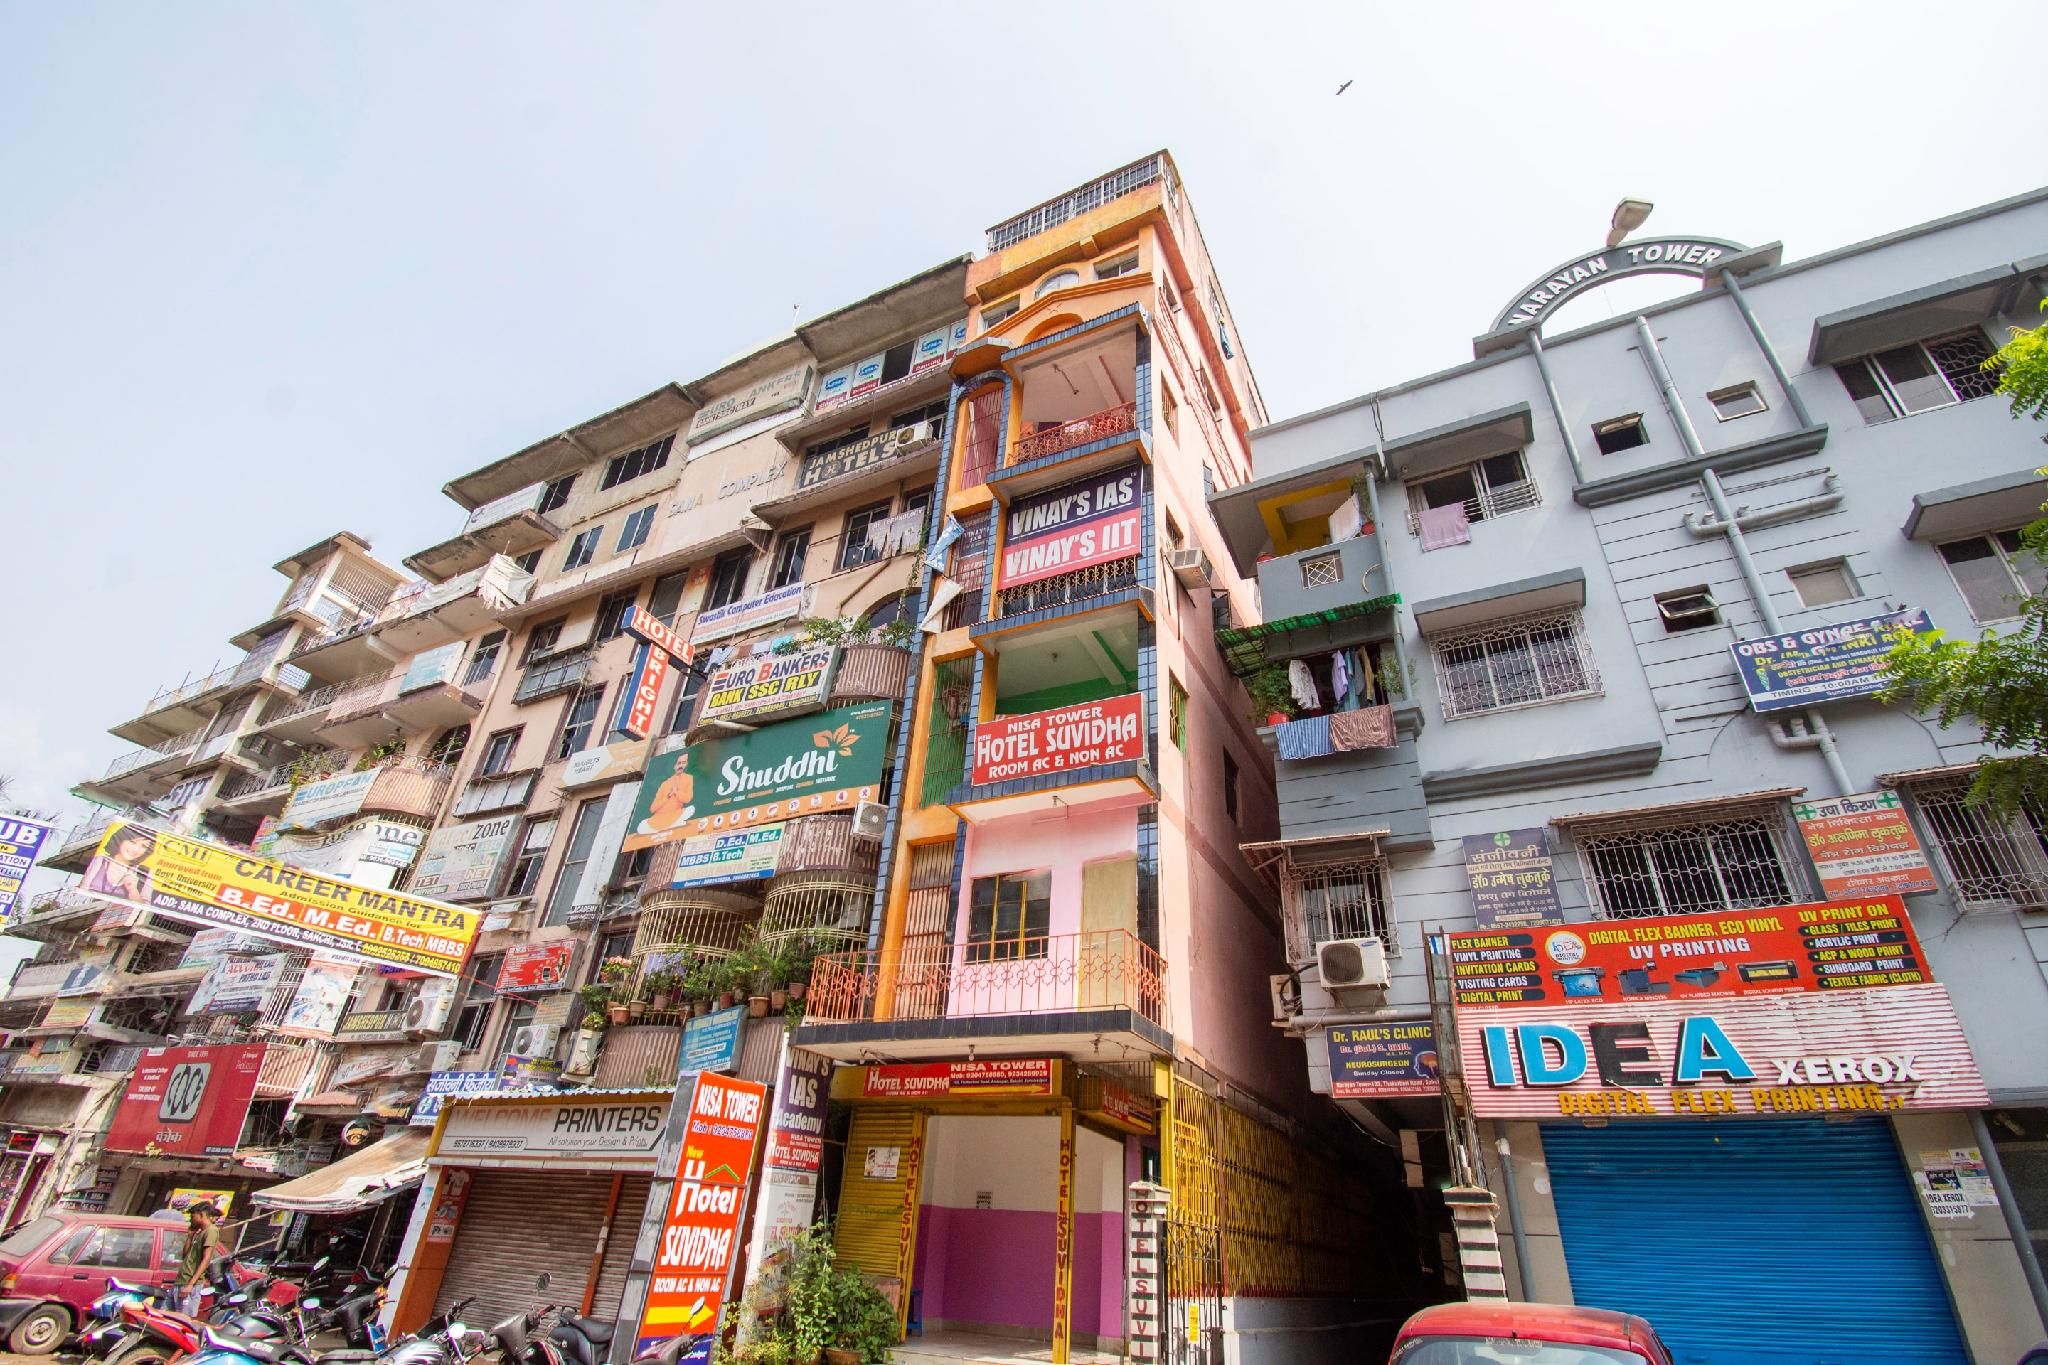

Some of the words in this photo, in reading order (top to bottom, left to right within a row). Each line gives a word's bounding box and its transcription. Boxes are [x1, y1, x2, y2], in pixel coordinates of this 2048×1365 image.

[1508, 257, 1608, 326] NARAYAN
[1628, 245, 1722, 264] TOWER
[809, 430, 897, 469] JAMSHEDPUR
[719, 461, 788, 499] COMPLEX
[1013, 490, 1091, 536] VINAY'S
[1095, 477, 1133, 511] IAS
[1005, 529, 1095, 578] VINAY'S
[1101, 517, 1137, 551] IIT
[636, 607, 692, 665] HOTEL
[1739, 640, 1778, 657] OBS
[1781, 637, 1797, 649] &
[712, 668, 756, 692] EURO
[757, 651, 829, 682] BANKERS
[633, 644, 669, 729] BRIGHT
[748, 680, 780, 700] SSC
[783, 671, 819, 692] RLY
[1770, 686, 1811, 698] TIMING
[1008, 718, 1041, 734] NISA
[1046, 706, 1102, 725] TOWER
[977, 730, 1039, 768] HOTEL
[1046, 712, 1137, 753] SUVIDHA
[989, 761, 1028, 779] ROOM
[1032, 756, 1050, 771] AC
[1054, 754, 1064, 767] &
[1069, 748, 1100, 764] NON
[1105, 743, 1124, 760] AC
[718, 751, 840, 796] Shuddhi
[1840, 799, 1878, 815] किरण
[716, 835, 746, 849] D.Ed.
[748, 830, 780, 845] M.Ed.
[680, 853, 710, 867] MBBS
[712, 849, 743, 862] B.Tech
[234, 858, 350, 902] CAREER
[357, 890, 466, 931] MANTRA
[178, 899, 205, 915] SANA
[221, 886, 296, 919] B.Ed.
[304, 907, 378, 939] M.Ed.
[279, 890, 345, 911] Admission
[347, 905, 403, 926] Guidance
[1799, 909, 1816, 923] UV
[1819, 905, 1862, 921] PRINT
[1868, 903, 1889, 917] ON
[382, 925, 424, 949] B.Tech
[1589, 929, 1631, 945] DIGITAL
[1633, 927, 1662, 942] FLEX
[1663, 922, 1718, 940] BANNER,
[1719, 920, 1746, 934] ECO
[1746, 916, 1784, 933] VINYL
[1808, 923, 1839, 935] GLASS
[1845, 921, 1868, 932] TILES
[1869, 918, 1898, 930] PRINT
[426, 934, 466, 957] MBBS
[1451, 938, 1473, 950] FLEX
[1474, 936, 1509, 947] BANNER
[1629, 945, 1655, 960] UV
[1660, 937, 1751, 959] PRINTING
[1814, 936, 1852, 948] ACRYLIC
[1853, 933, 1880, 945] PRINT
[1819, 949, 1838, 961] ACP
[1839, 948, 1847, 959] &
[1848, 946, 1876, 959] WOOD
[1877, 944, 1905, 956] PRINT
[1453, 951, 1479, 963] VINYL
[1480, 948, 1521, 961] PRINTING
[1823, 961, 1872, 974] SUNBOARD
[1877, 958, 1904, 970] PRINT
[1456, 964, 1504, 976] INVITATION
[1505, 961, 1536, 973] CARDS
[1826, 976, 1858, 988] TEXTILE
[1859, 973, 1888, 985] FABRIC
[1889, 971, 1922, 984] (CLOTH)
[1458, 978, 1496, 989] VISITING
[1497, 975, 1528, 987] CARDS
[1461, 992, 1495, 1003] DIGITAL
[1496, 989, 1523, 1001] PRINT
[1333, 1031, 1349, 1042] Dr.
[1352, 1029, 1391, 1041] RAUL'S
[1393, 1027, 1432, 1039] CLINIC
[1479, 1015, 1758, 1089] IDEA
[951, 1063, 987, 1072] NISA
[991, 1060, 1047, 1070] TOWER
[1345, 1060, 1410, 1069] NEUROSURGEON
[1770, 1055, 1923, 1085] XEROX
[788, 1075, 818, 1108] IAS
[867, 1069, 902, 1091] HOTEL
[904, 1077, 950, 1090] SUVIDHA
[695, 1083, 722, 1117] NISA
[723, 1088, 760, 1124] TOWER
[1558, 1091, 1656, 1114] DIGITAL
[1670, 1089, 1738, 1114] FLEX
[1751, 1083, 1884, 1112] PRINTING
[553, 1105, 662, 1133] PRINTERS
[686, 1145, 704, 1160] New
[1059, 1139, 1071, 1214] HOTEL
[676, 1160, 738, 1218] Hotel
[1926, 1193, 1943, 1203] IDEA
[1942, 1193, 1965, 1203] XEROX
[660, 1225, 732, 1272] SUVIDHA
[653, 1277, 677, 1293] ROOM
[677, 1278, 688, 1292] AC
[694, 1277, 711, 1292] NON
[711, 1278, 721, 1292] AC
